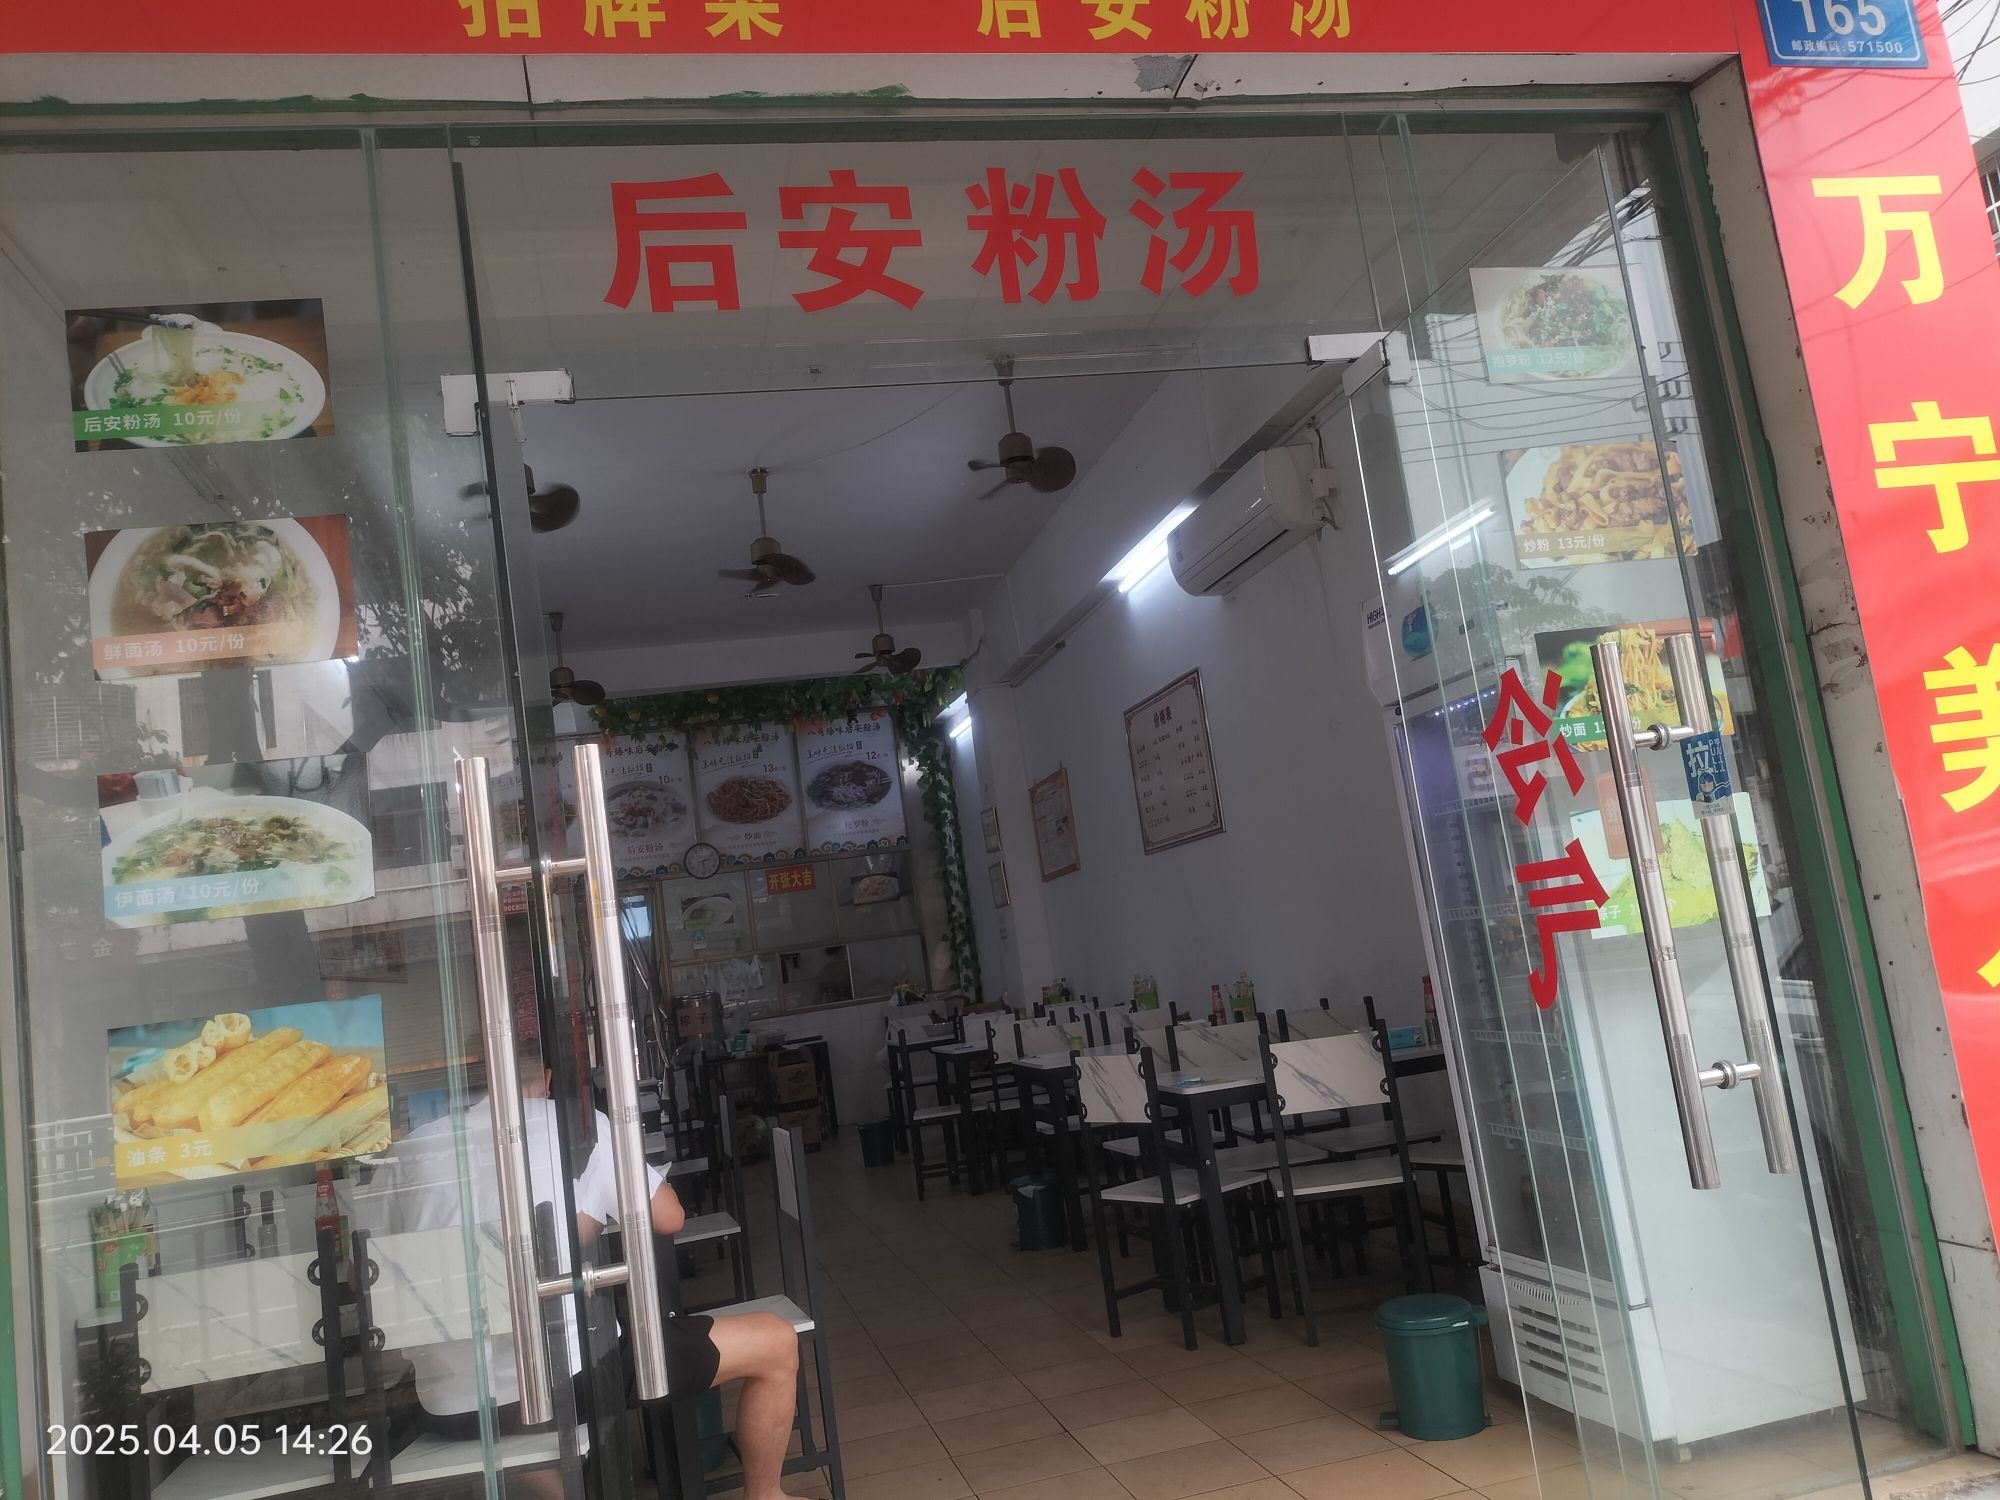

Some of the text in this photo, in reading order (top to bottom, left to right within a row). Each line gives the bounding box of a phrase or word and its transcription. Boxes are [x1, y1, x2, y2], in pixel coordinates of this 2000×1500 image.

[1798, 0, 1887, 36] 165
[603, 166, 1261, 313] 后安粉汤
[84, 408, 241, 433] 后安粉汤 10元/份
[1523, 534, 1605, 553] 炒粉 13元/份
[1811, 175, 2000, 989] 万宁美
[104, 632, 246, 660] 鲜面汤 10元/份
[1559, 721, 1587, 738] 炒面
[1686, 740, 1714, 777] 拉
[115, 877, 260, 909] 伊面汤 10元/份
[768, 867, 812, 890] 开张大吉
[127, 1139, 213, 1168] 油条 3元
